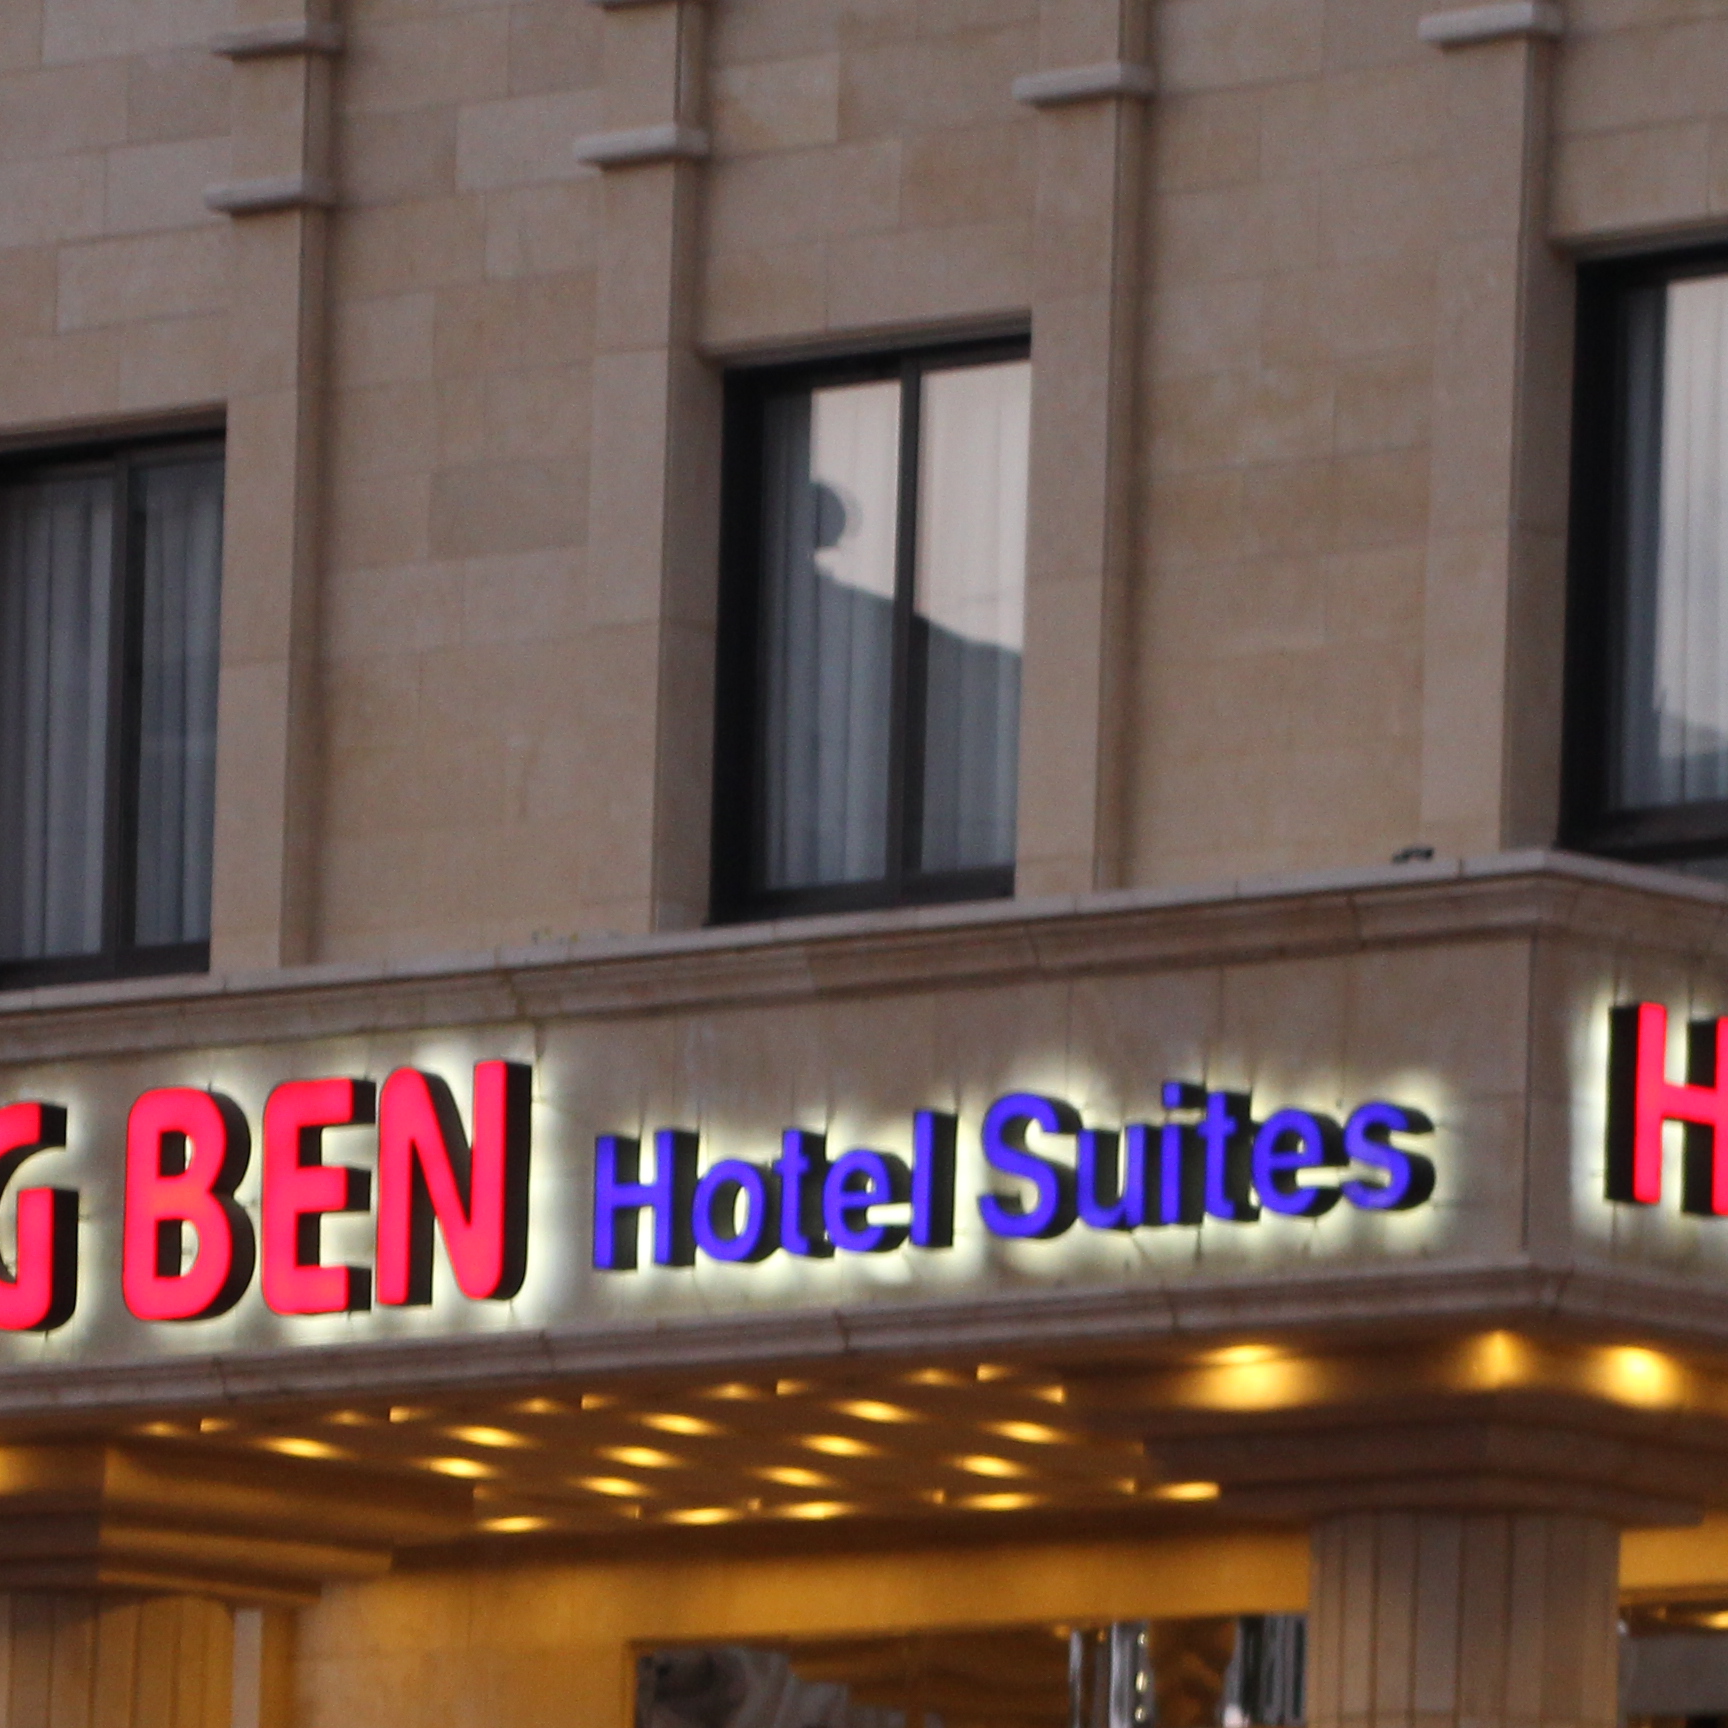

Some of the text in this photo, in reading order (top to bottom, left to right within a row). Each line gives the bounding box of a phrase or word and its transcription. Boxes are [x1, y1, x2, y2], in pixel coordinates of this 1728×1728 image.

[121, 1059, 522, 1321] BEN
[593, 1110, 946, 1270] Hotel
[978, 1081, 1424, 1240] Suites
